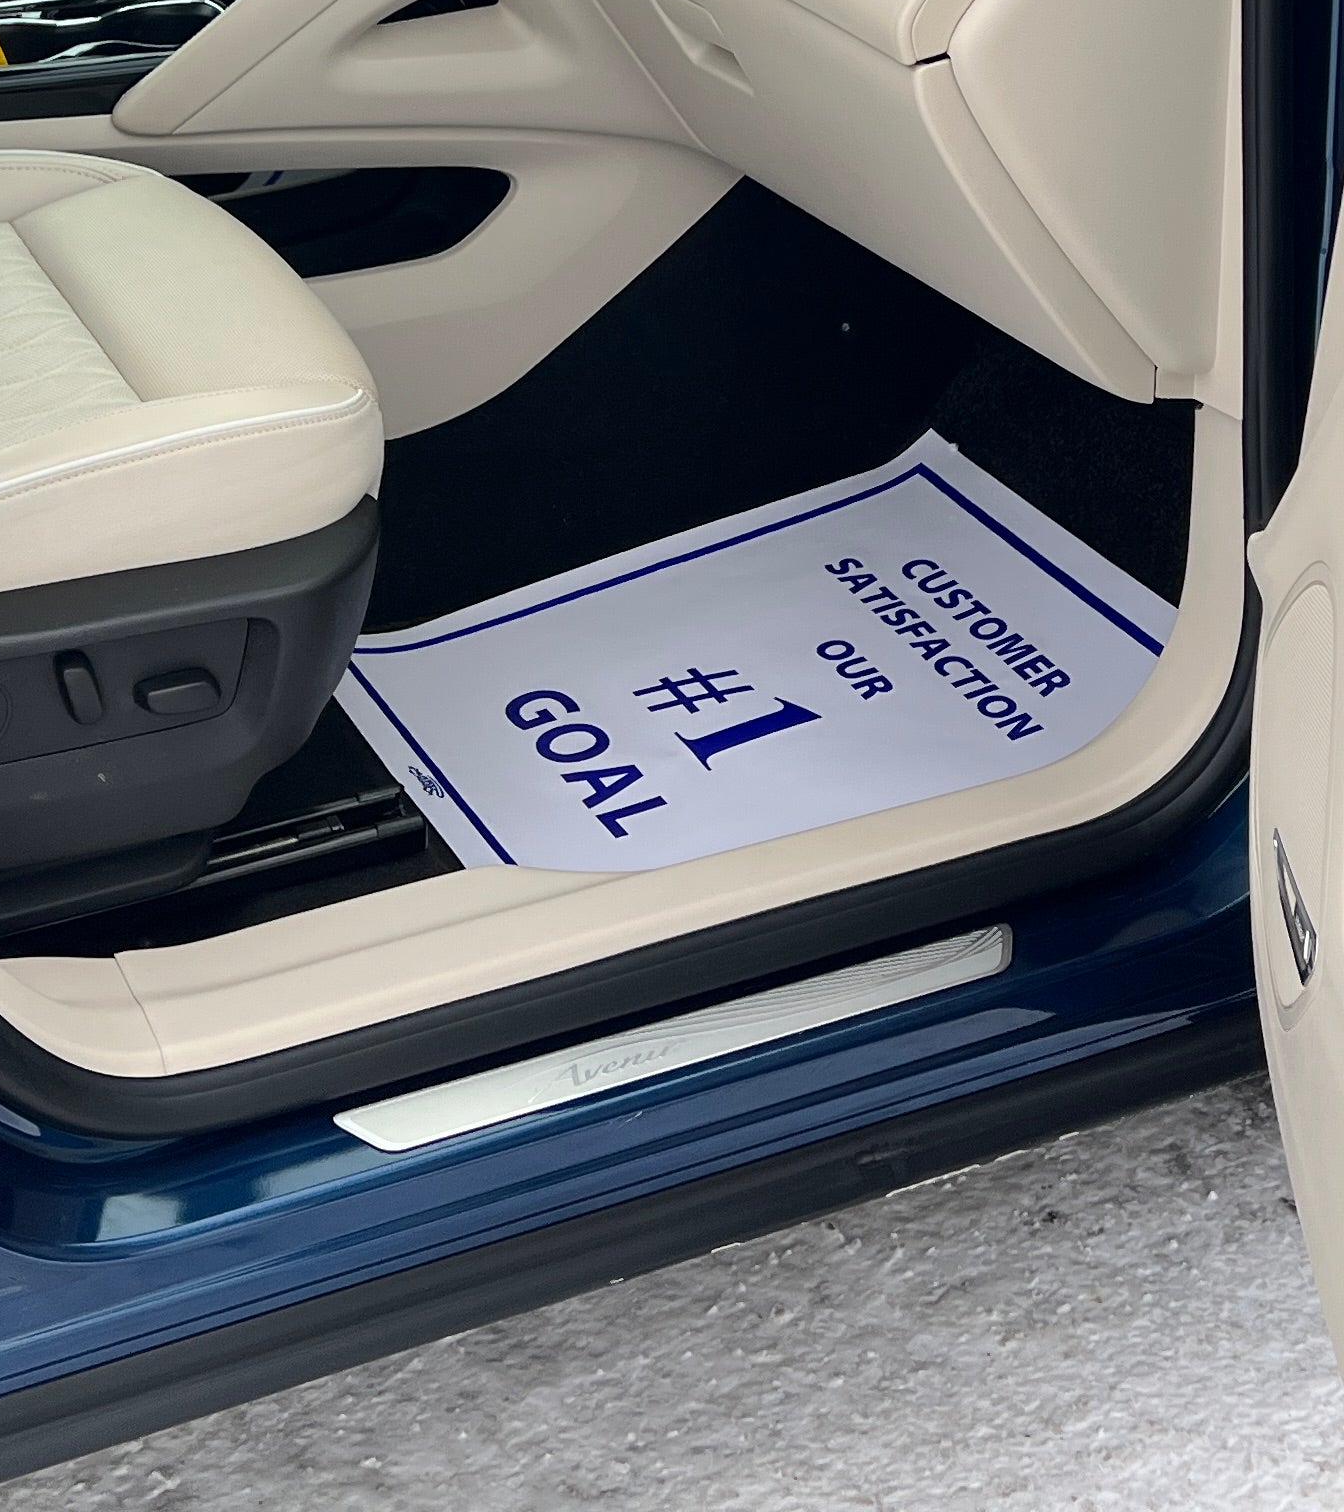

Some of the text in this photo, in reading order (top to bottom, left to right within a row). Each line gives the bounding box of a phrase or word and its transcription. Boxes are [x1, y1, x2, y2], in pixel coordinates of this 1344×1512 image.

[816, 640, 894, 700] OUR
[824, 558, 1044, 741] SATISFACTION
[902, 559, 1071, 697] CUSTOMER
[505, 690, 668, 838] GOAL
[632, 667, 823, 771] #1
